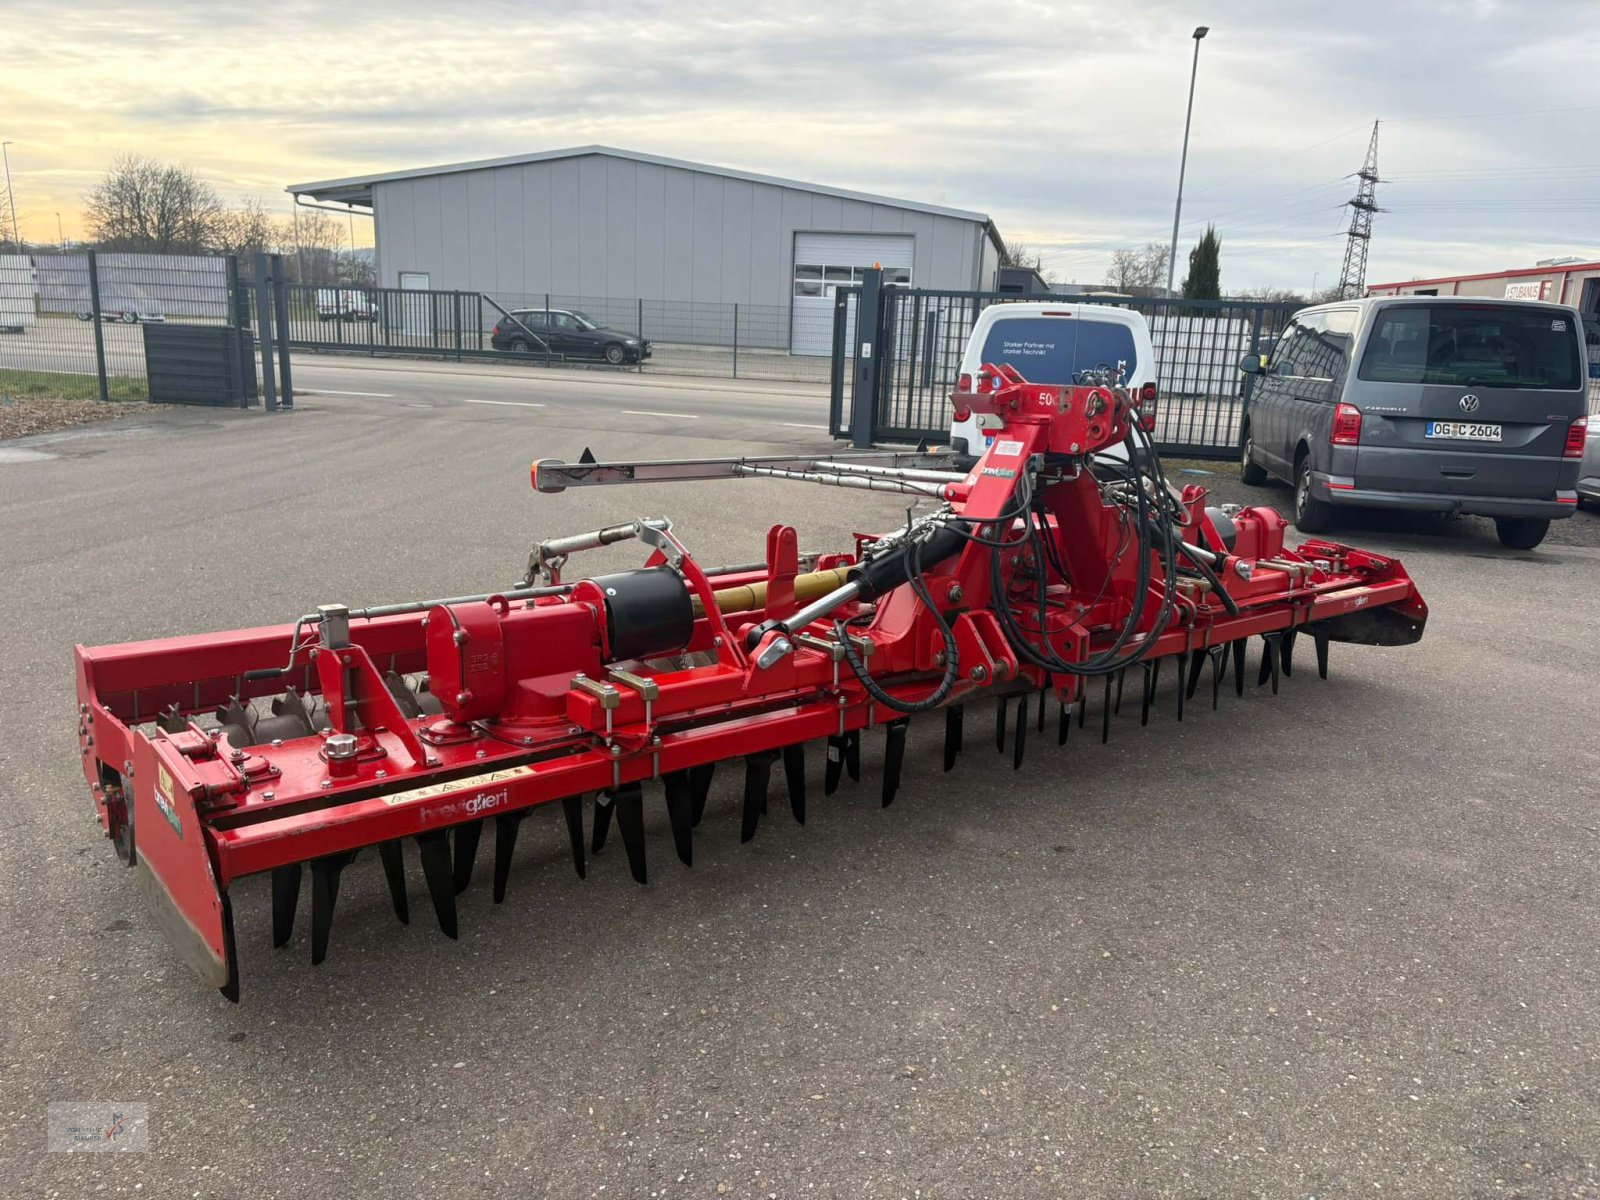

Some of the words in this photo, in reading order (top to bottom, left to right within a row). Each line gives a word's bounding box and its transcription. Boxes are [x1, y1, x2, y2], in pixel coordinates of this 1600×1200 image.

[1434, 423, 1450, 435] OG
[1458, 424, 1466, 435] C
[1469, 425, 1500, 437] 2604
